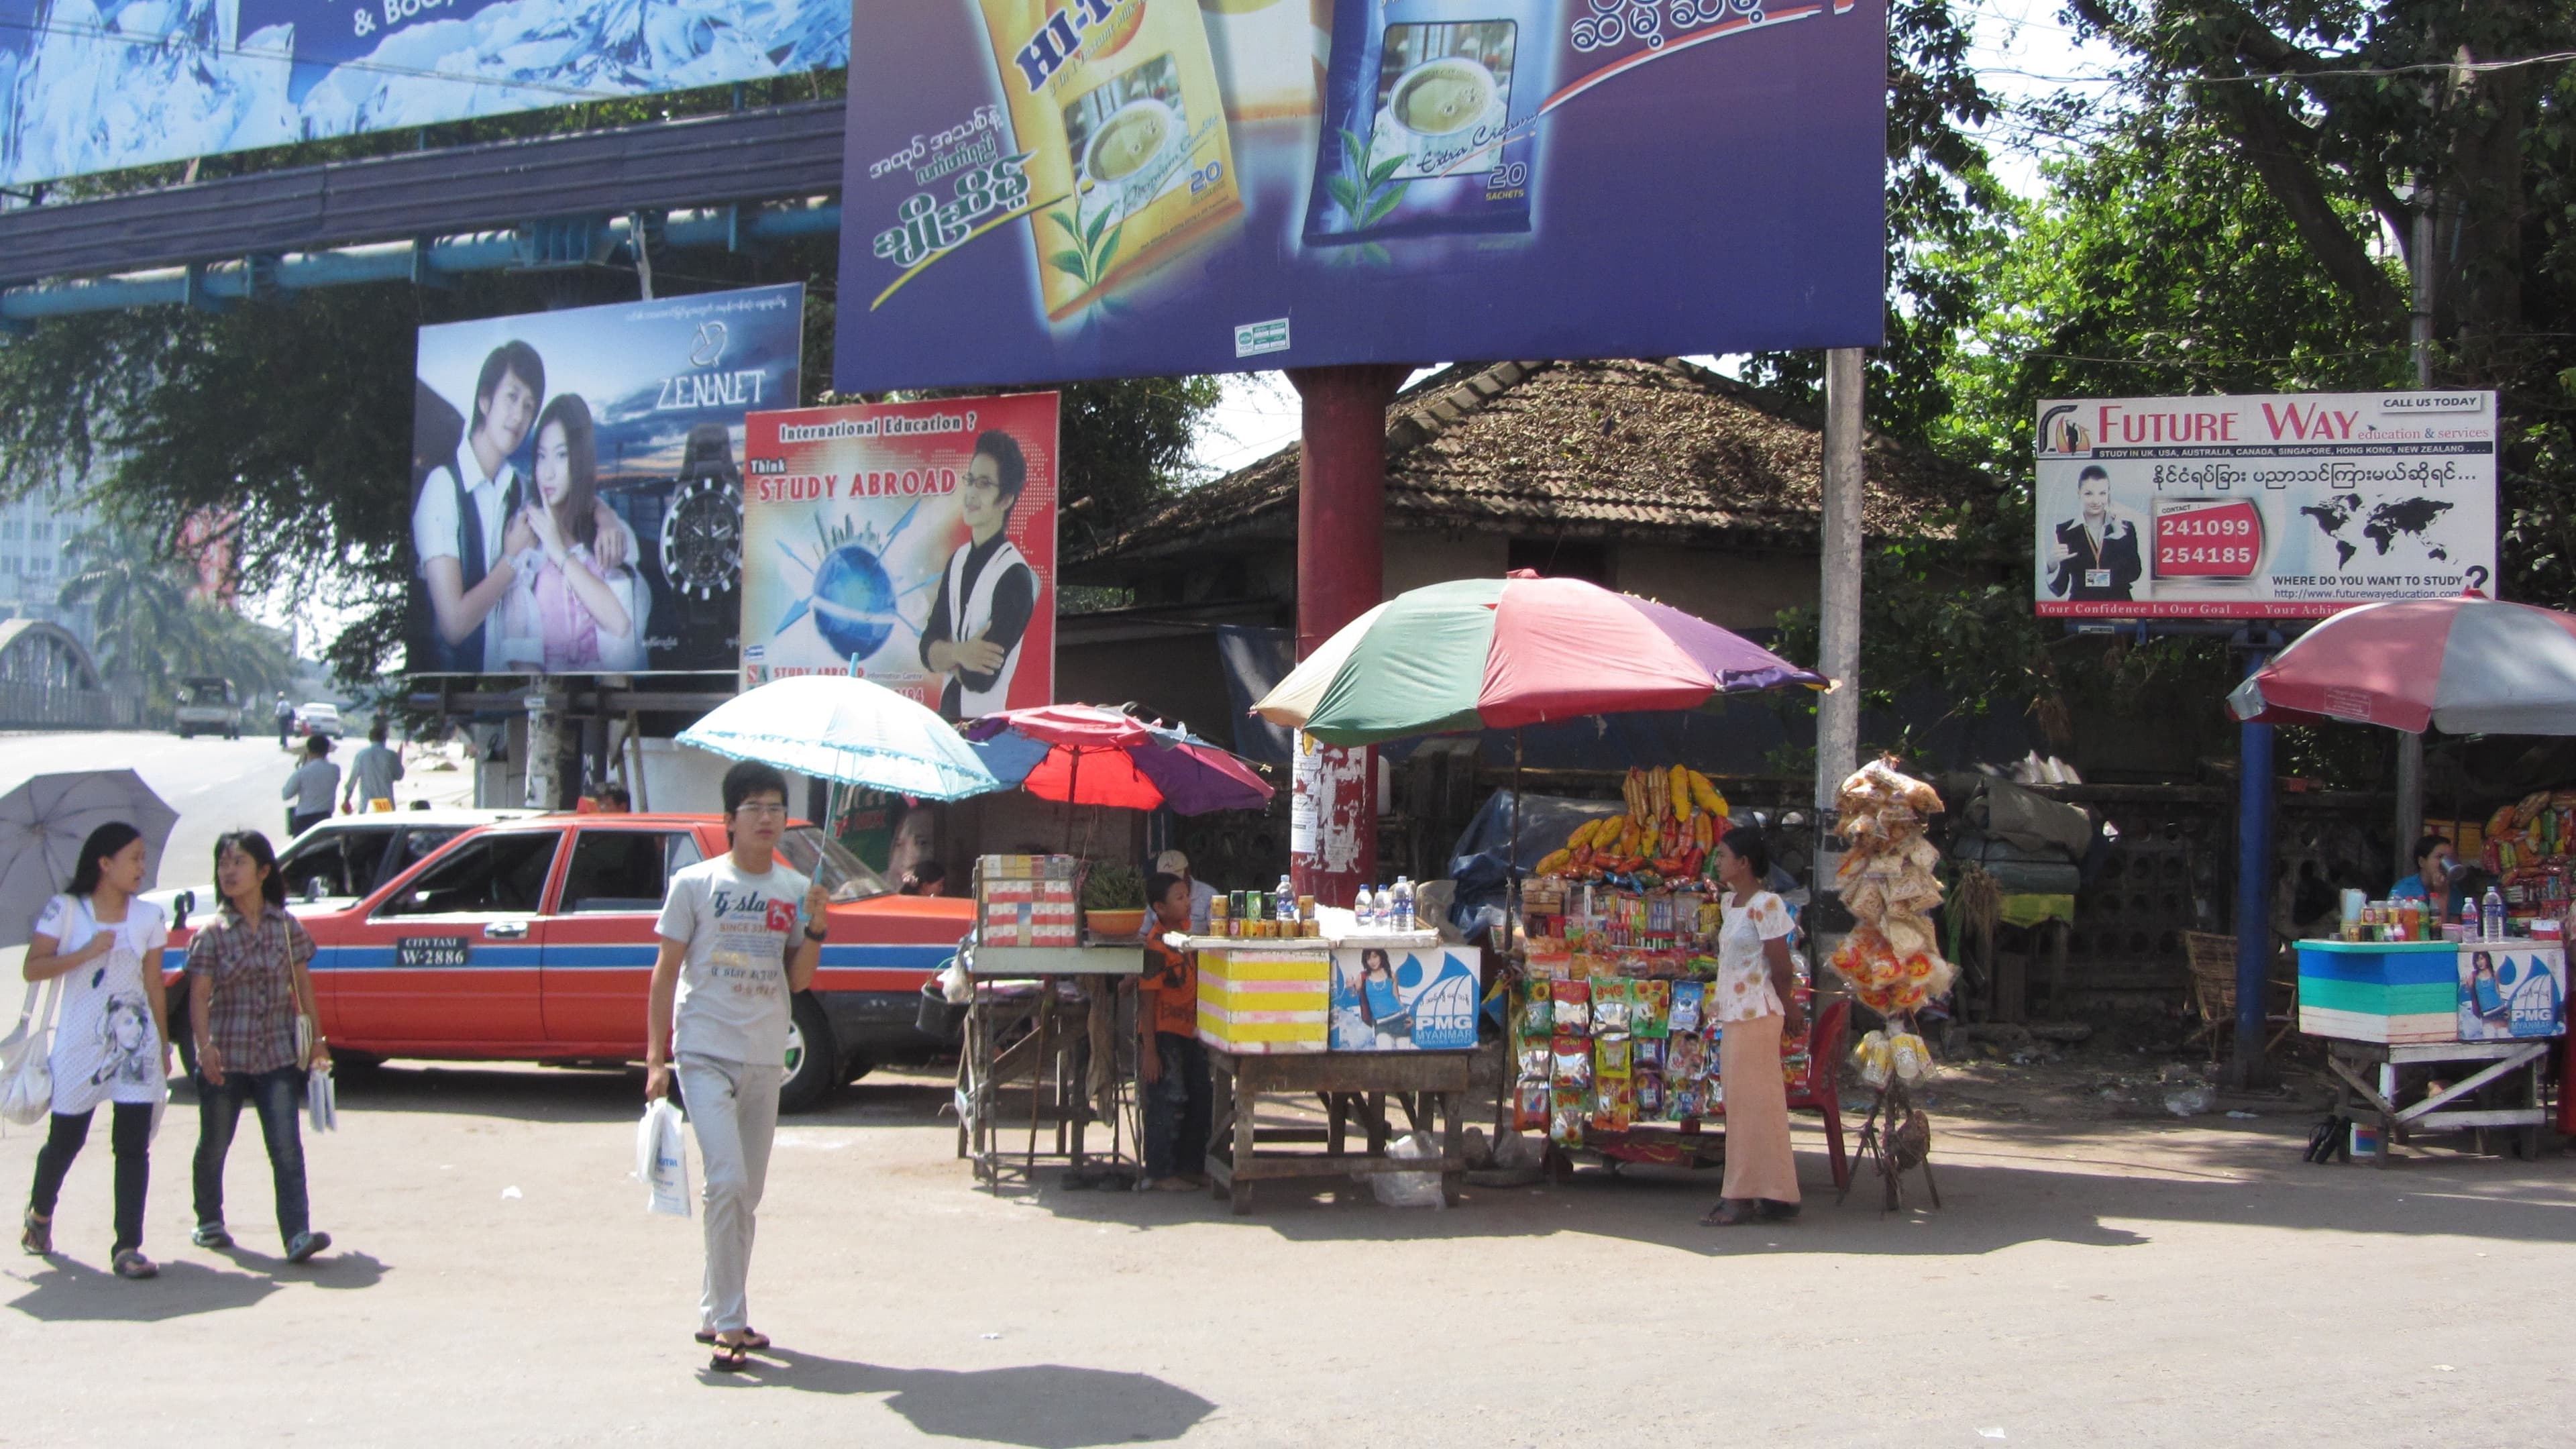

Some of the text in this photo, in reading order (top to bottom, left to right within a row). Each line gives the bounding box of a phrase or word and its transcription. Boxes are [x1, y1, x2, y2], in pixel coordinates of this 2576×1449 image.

[354, 8, 376, 37] &
[1416, 111, 1541, 173] Extra Creamy
[1189, 160, 1223, 195] 20
[1487, 160, 1527, 190] 20
[1486, 189, 1525, 201] SACHETS
[655, 368, 766, 411] ZENNET
[2383, 397, 2477, 407] CALL US TODAY
[780, 419, 879, 441] International
[885, 414, 961, 434] Education
[2099, 402, 2359, 443] FUTURE WAY
[2358, 427, 2489, 441] education & services
[2099, 449, 2128, 458] STUDY
[2129, 448, 2140, 458] IN
[2158, 448, 2180, 458] USA,
[2181, 448, 2234, 458] AUSTRALIA,
[2235, 447, 2276, 457] CANADA,
[2277, 447, 2334, 457] SINGAPORE,
[2337, 446, 2364, 455] HONG
[2365, 446, 2396, 456] KONG,
[2397, 445, 2420, 454] NEW
[2420, 445, 2465, 453] ZEALAND
[750, 458, 786, 474] Think
[759, 468, 957, 502] STUDY ABROAD
[2161, 504, 2191, 515] CONTACT
[2161, 519, 2250, 537] 241099
[2161, 547, 2251, 564] 254185
[2272, 576, 2316, 586] WHERE
[2319, 576, 2337, 586] DO
[2339, 576, 2364, 586] YOU
[2366, 576, 2404, 586] WANT
[2405, 576, 2421, 586] TO
[2039, 603, 2070, 614] Your
[2075, 603, 2148, 614] Confidence
[2152, 603, 2165, 614] Is
[2169, 603, 2196, 614] Our
[2200, 603, 2231, 614] Goal
[2264, 603, 2298, 614] Your
[405, 938, 458, 947] CITY TAXI
[1415, 1015, 1472, 1030] PMG
[2511, 1010, 2552, 1022] PMG
[1415, 1030, 1472, 1040] MYANMAR
